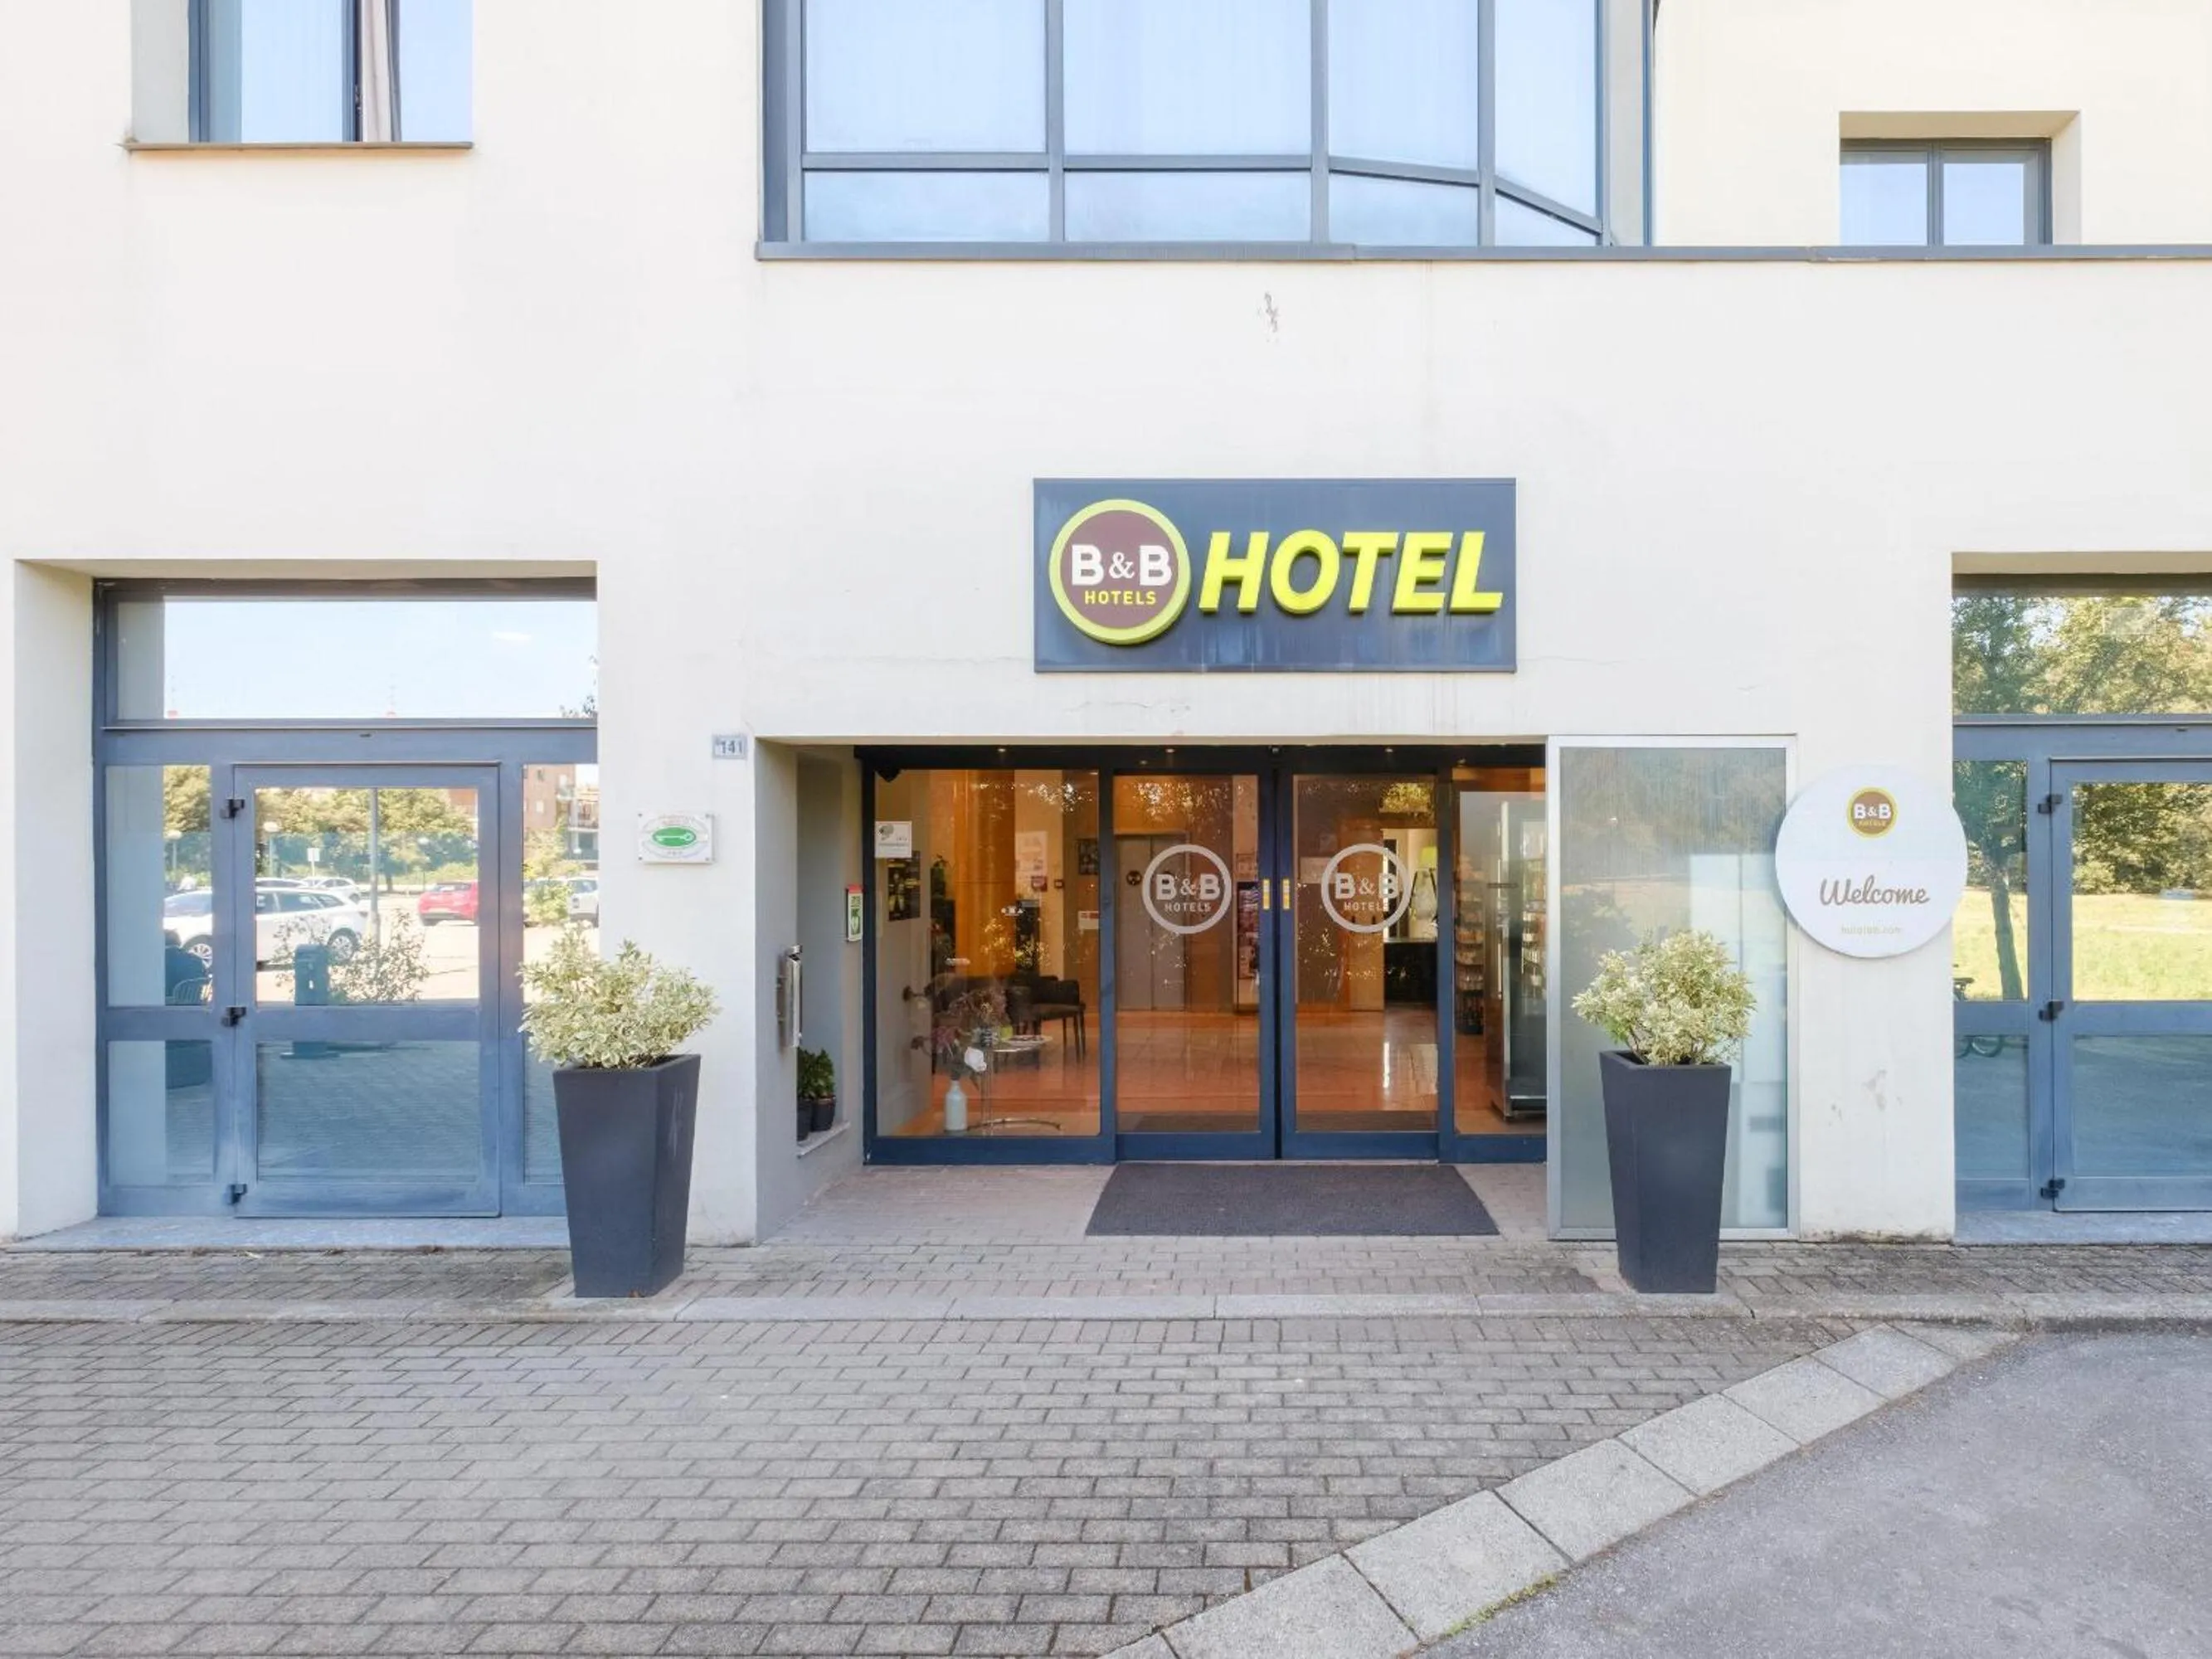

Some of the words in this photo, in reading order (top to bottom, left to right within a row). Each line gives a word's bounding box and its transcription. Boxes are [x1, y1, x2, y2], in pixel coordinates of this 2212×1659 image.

[1072, 544, 1172, 586] B&B
[1198, 529, 1503, 614] HOTEL
[1084, 590, 1156, 605] HOTELS
[721, 740, 743, 754] 141
[1854, 803, 1891, 819] B&B
[1155, 873, 1220, 901] B&B
[1334, 873, 1398, 900] B&B
[1820, 875, 1930, 905] Welcome
[1164, 902, 1212, 912] HOTELS
[1343, 902, 1390, 912] HOTELS
